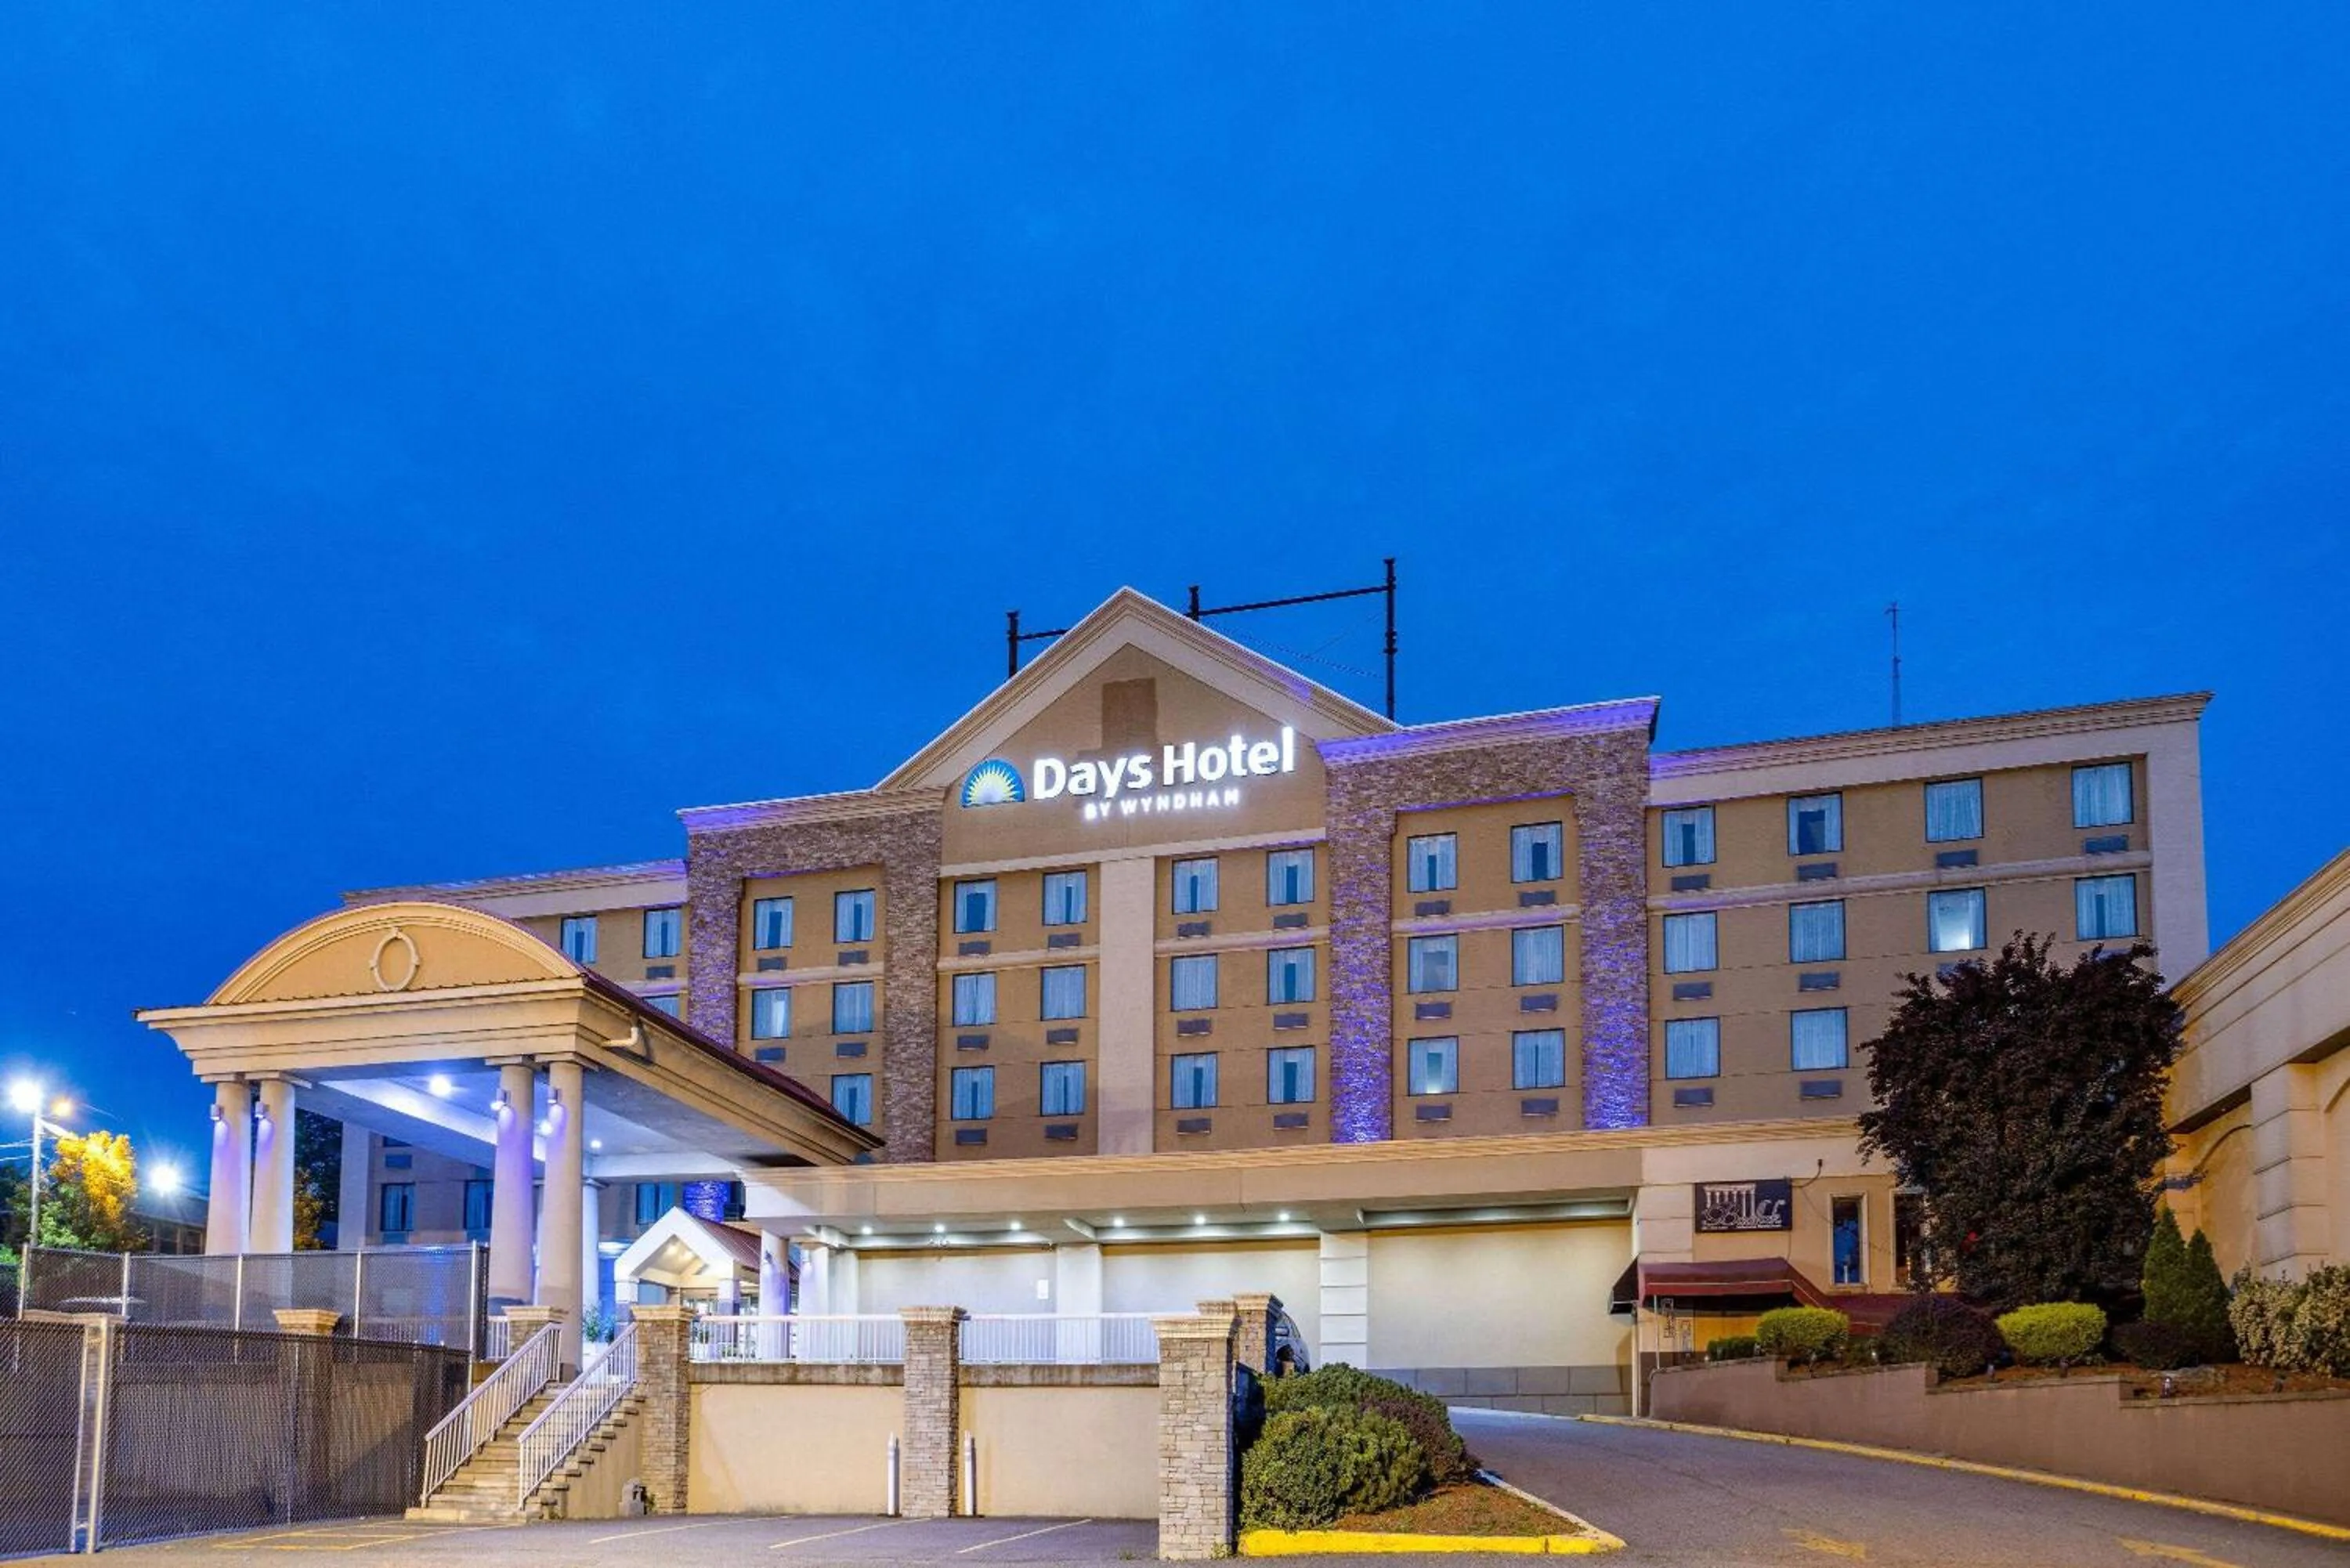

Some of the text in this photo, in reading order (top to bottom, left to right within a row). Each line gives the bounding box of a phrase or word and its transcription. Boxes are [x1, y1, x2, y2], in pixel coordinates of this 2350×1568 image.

[1032, 725, 1296, 800] Days Hotel
[1083, 789, 1239, 820] BY WYNDHAM
